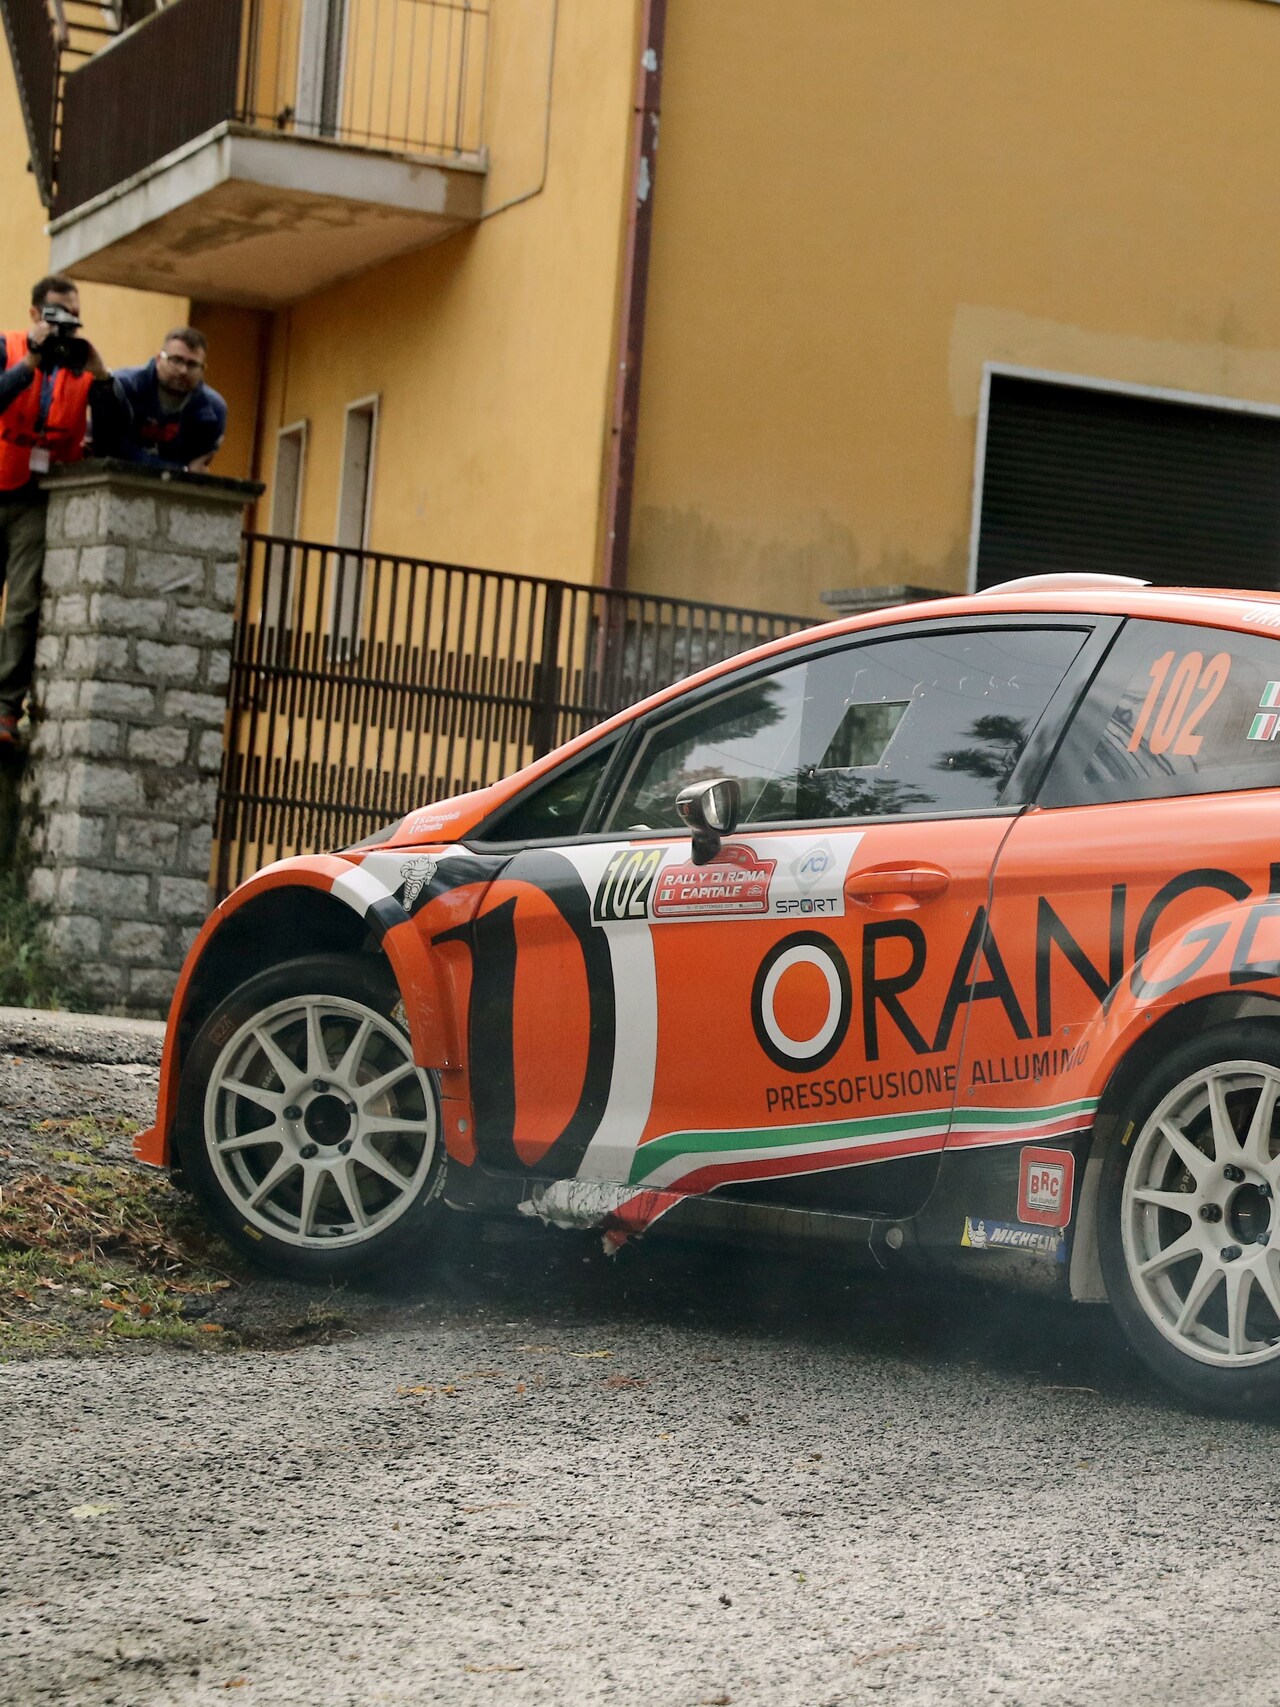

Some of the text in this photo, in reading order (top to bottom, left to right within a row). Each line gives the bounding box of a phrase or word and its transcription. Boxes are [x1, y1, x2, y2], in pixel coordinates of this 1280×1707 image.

[1127, 650, 1232, 756] 102
[601, 849, 662, 918] 102
[664, 869, 766, 886] RALLY DI ROMA
[680, 885, 742, 899] CAPITALE
[775, 898, 838, 913] SPORT
[766, 1041, 1088, 1113] PRESSOFUSIONE ALLUMINIO
[1030, 1171, 1059, 1197] BRC
[990, 1227, 1060, 1252] MICHELIN
